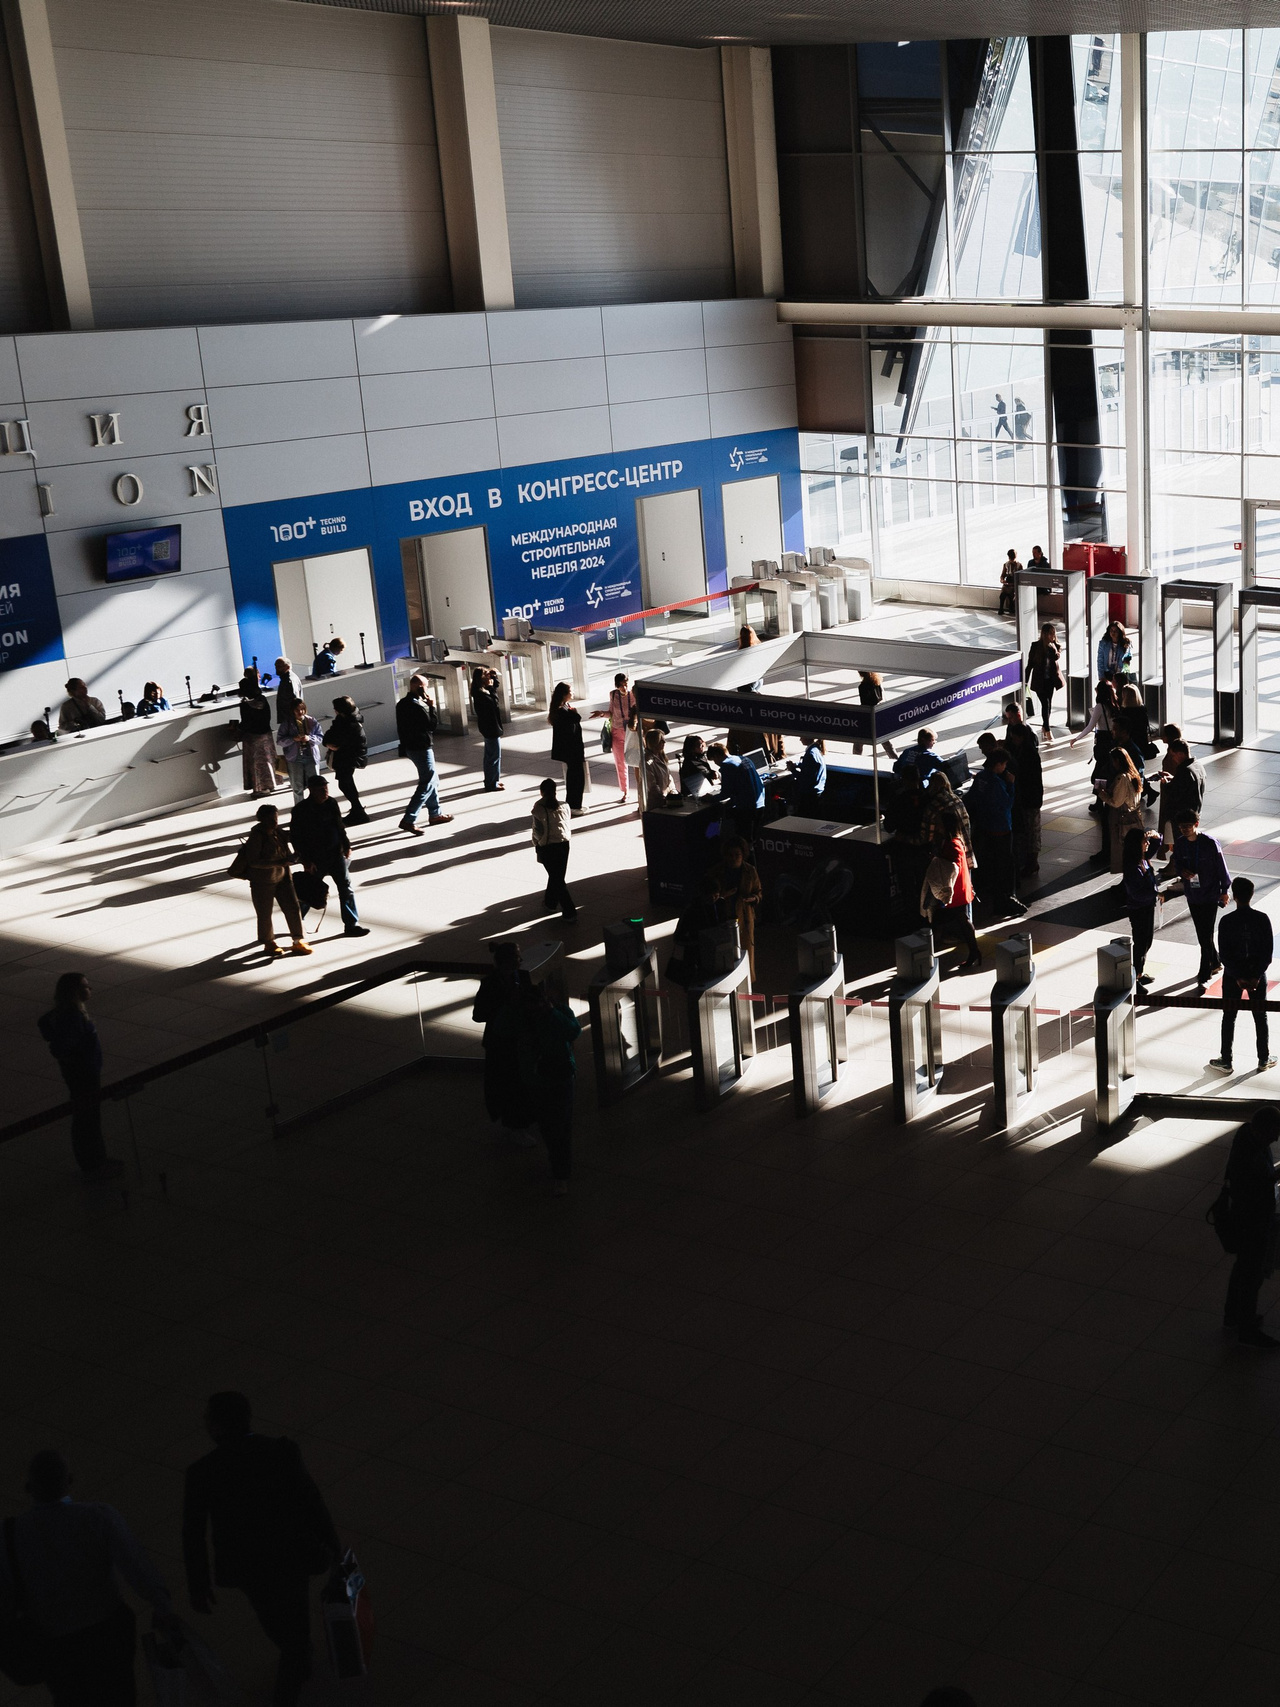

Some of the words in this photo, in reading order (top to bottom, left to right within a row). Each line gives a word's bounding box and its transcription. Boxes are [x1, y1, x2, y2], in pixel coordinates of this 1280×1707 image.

[409, 492, 473, 522] ВХОД
[488, 487, 503, 509] В
[517, 459, 684, 504] КОНГРЕСС-ЦЕНТР
[270, 516, 317, 543] 100+
[320, 516, 346, 526] TECHNO
[321, 524, 347, 535] BUILD
[511, 517, 618, 547] МЕЖДУНАРОДНАЯ
[521, 536, 611, 563] СТРОИТЕЛЬНАЯ
[531, 559, 578, 580] НЕДЕЛЯ
[579, 554, 606, 571] 2024
[544, 597, 565, 607] TECHNO
[544, 604, 565, 615] BUILD
[0, 629, 29, 648] ON
[898, 703, 930, 722] СТОЙКА
[931, 674, 1003, 710] САМОРЕГИСТРАЦИИ
[650, 696, 744, 715] СЕРВИС-СТОЙКА
[760, 708, 796, 720] БЮРО
[799, 713, 860, 728] НАХОДОК
